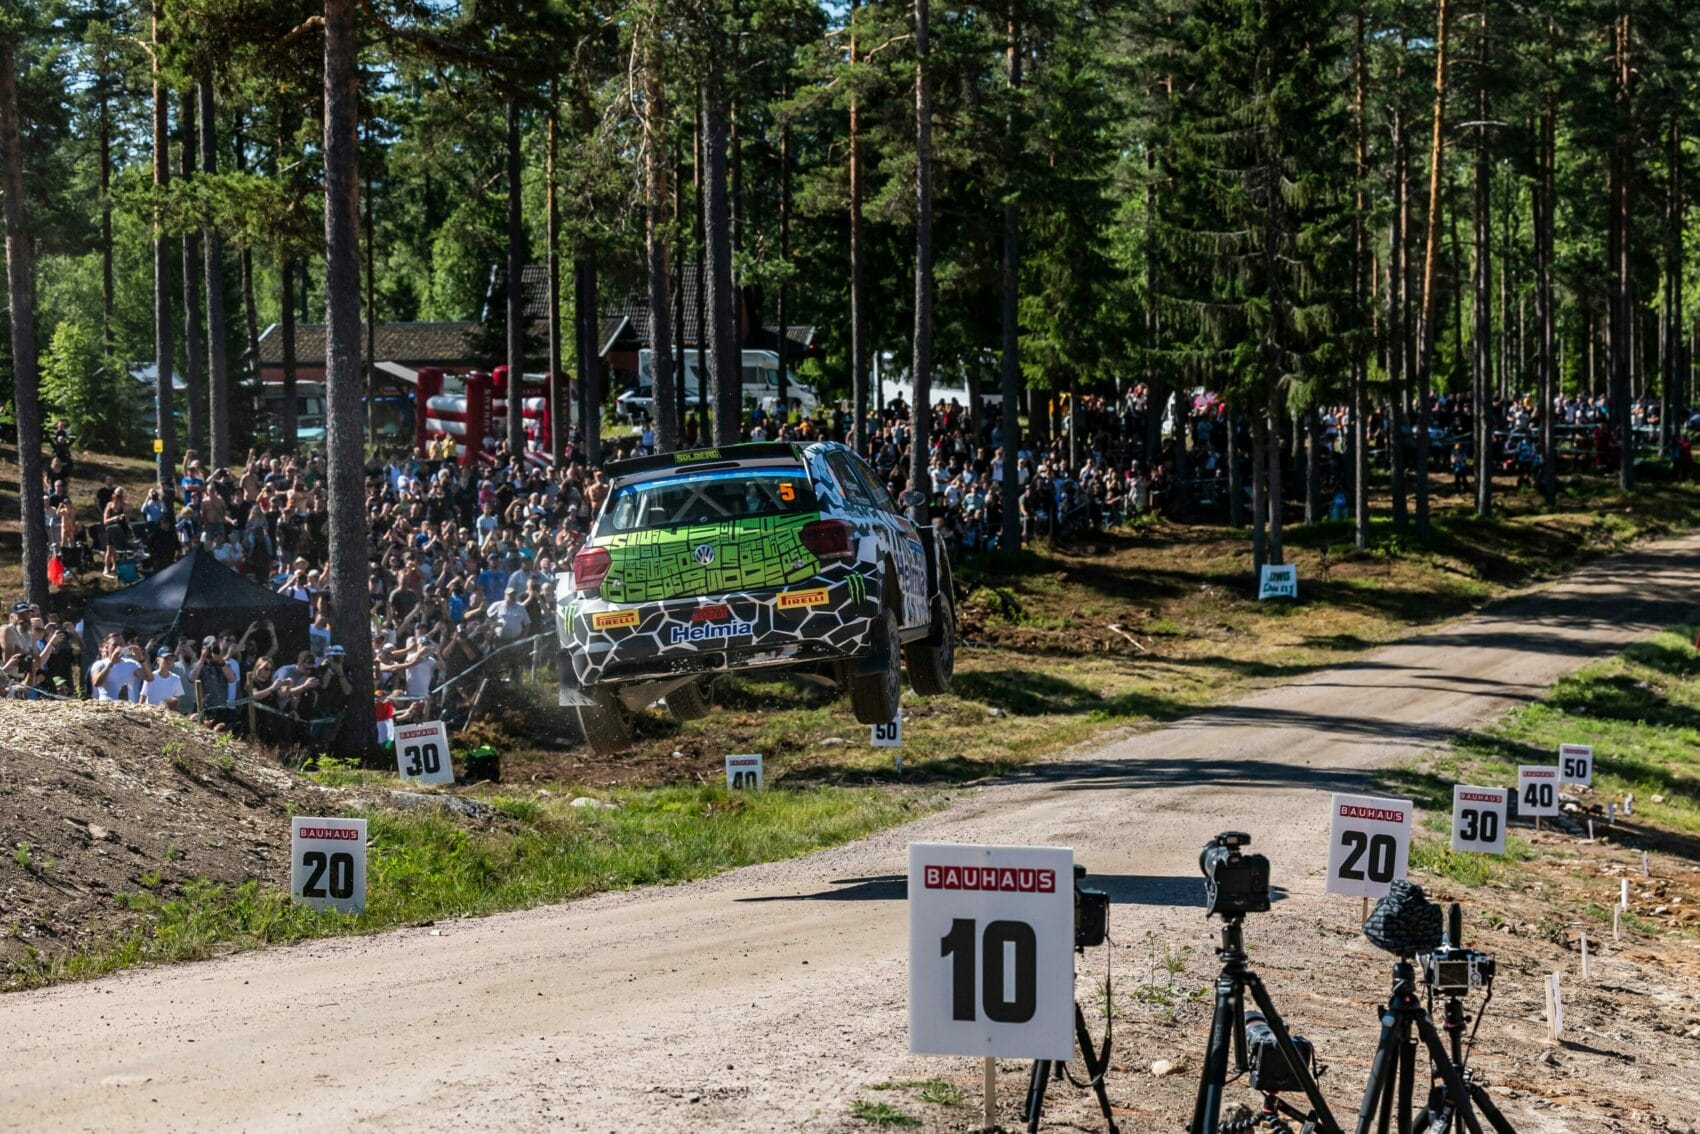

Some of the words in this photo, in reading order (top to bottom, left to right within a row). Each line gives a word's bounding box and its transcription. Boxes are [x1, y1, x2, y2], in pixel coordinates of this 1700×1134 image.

[676, 449, 719, 463] SOLBERG
[779, 482, 796, 501] 5
[780, 591, 825, 606] PIRELLI
[596, 612, 635, 627] PIRELLI
[671, 620, 753, 644] Helmia
[400, 728, 438, 739] BAUHAUS
[875, 723, 897, 740] 50
[404, 743, 441, 777] 30
[1564, 758, 1587, 778] 50
[731, 771, 757, 790] 40
[1460, 793, 1502, 803] BAUHAUS
[1523, 783, 1553, 808] 40
[1340, 806, 1403, 822] BAUHAUS
[300, 828, 358, 839] BAUHAUS
[1459, 809, 1498, 843] 30
[1338, 830, 1397, 884] 20
[302, 851, 355, 899] 20
[927, 870, 1053, 889] BAUHAUS
[941, 918, 1037, 1024] 10
